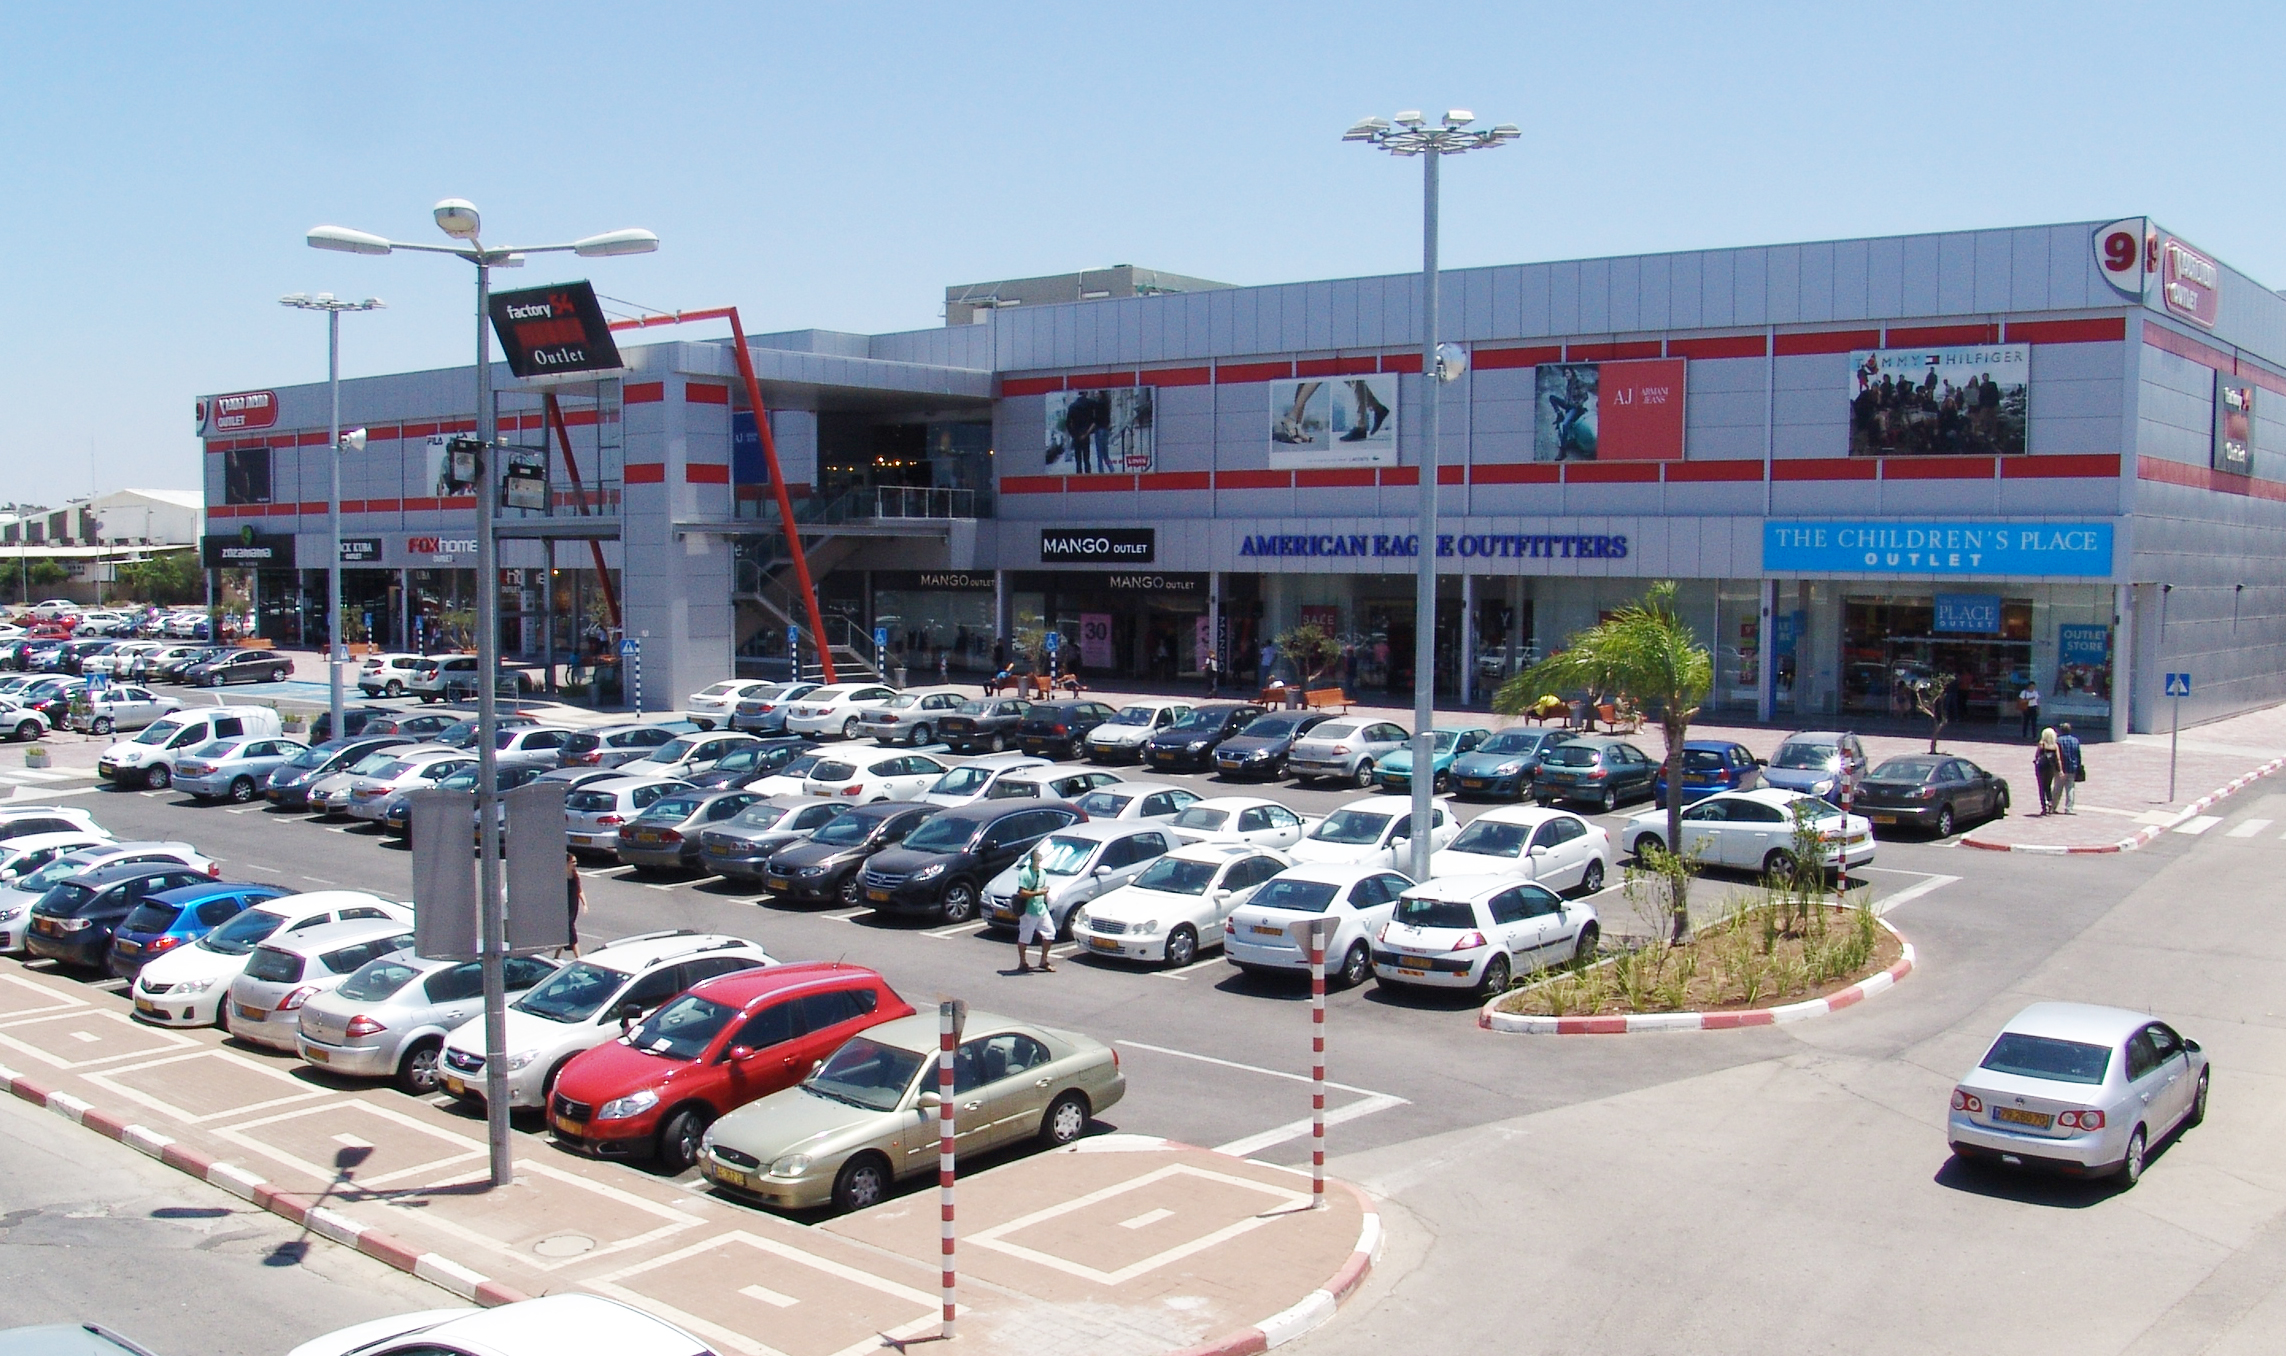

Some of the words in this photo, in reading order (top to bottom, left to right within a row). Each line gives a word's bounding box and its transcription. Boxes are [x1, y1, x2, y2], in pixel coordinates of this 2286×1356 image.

[2105, 232, 2136, 272] 9
[507, 304, 551, 319] factory
[548, 293, 576, 315] 54
[534, 348, 585, 365] Outlet
[1946, 352, 2023, 364] HILFIGER
[1614, 388, 1632, 405] AJ
[1642, 387, 1669, 396] ARMANI
[1643, 395, 1665, 404] JEANS
[218, 415, 245, 428] OUTLET
[427, 437, 444, 446] FILA
[1043, 537, 1110, 554] MANGO
[1113, 543, 1148, 554] OUTLET
[1776, 528, 1827, 548] THE
[1838, 528, 2009, 550] CHILDREN'S
[2020, 531, 2098, 551] PLACE
[353, 542, 373, 553] KUBA
[1239, 534, 1370, 557] AMERICAN
[1372, 534, 1454, 558] EAGE
[1457, 534, 1629, 559] OUTFITTERS
[1864, 552, 1983, 567] OUTLET
[920, 574, 969, 587] MANGO
[969, 579, 995, 587] OUTLET
[1109, 576, 1164, 589] MANGO
[1165, 581, 1194, 590] OUTLET
[1303, 613, 1334, 625] SALE
[1939, 605, 1995, 621] PLACE
[1939, 620, 1993, 628] OUTLET
[1084, 622, 1108, 641] 30
[2063, 629, 2106, 640] OUTLET
[2067, 641, 2103, 651] STORE
